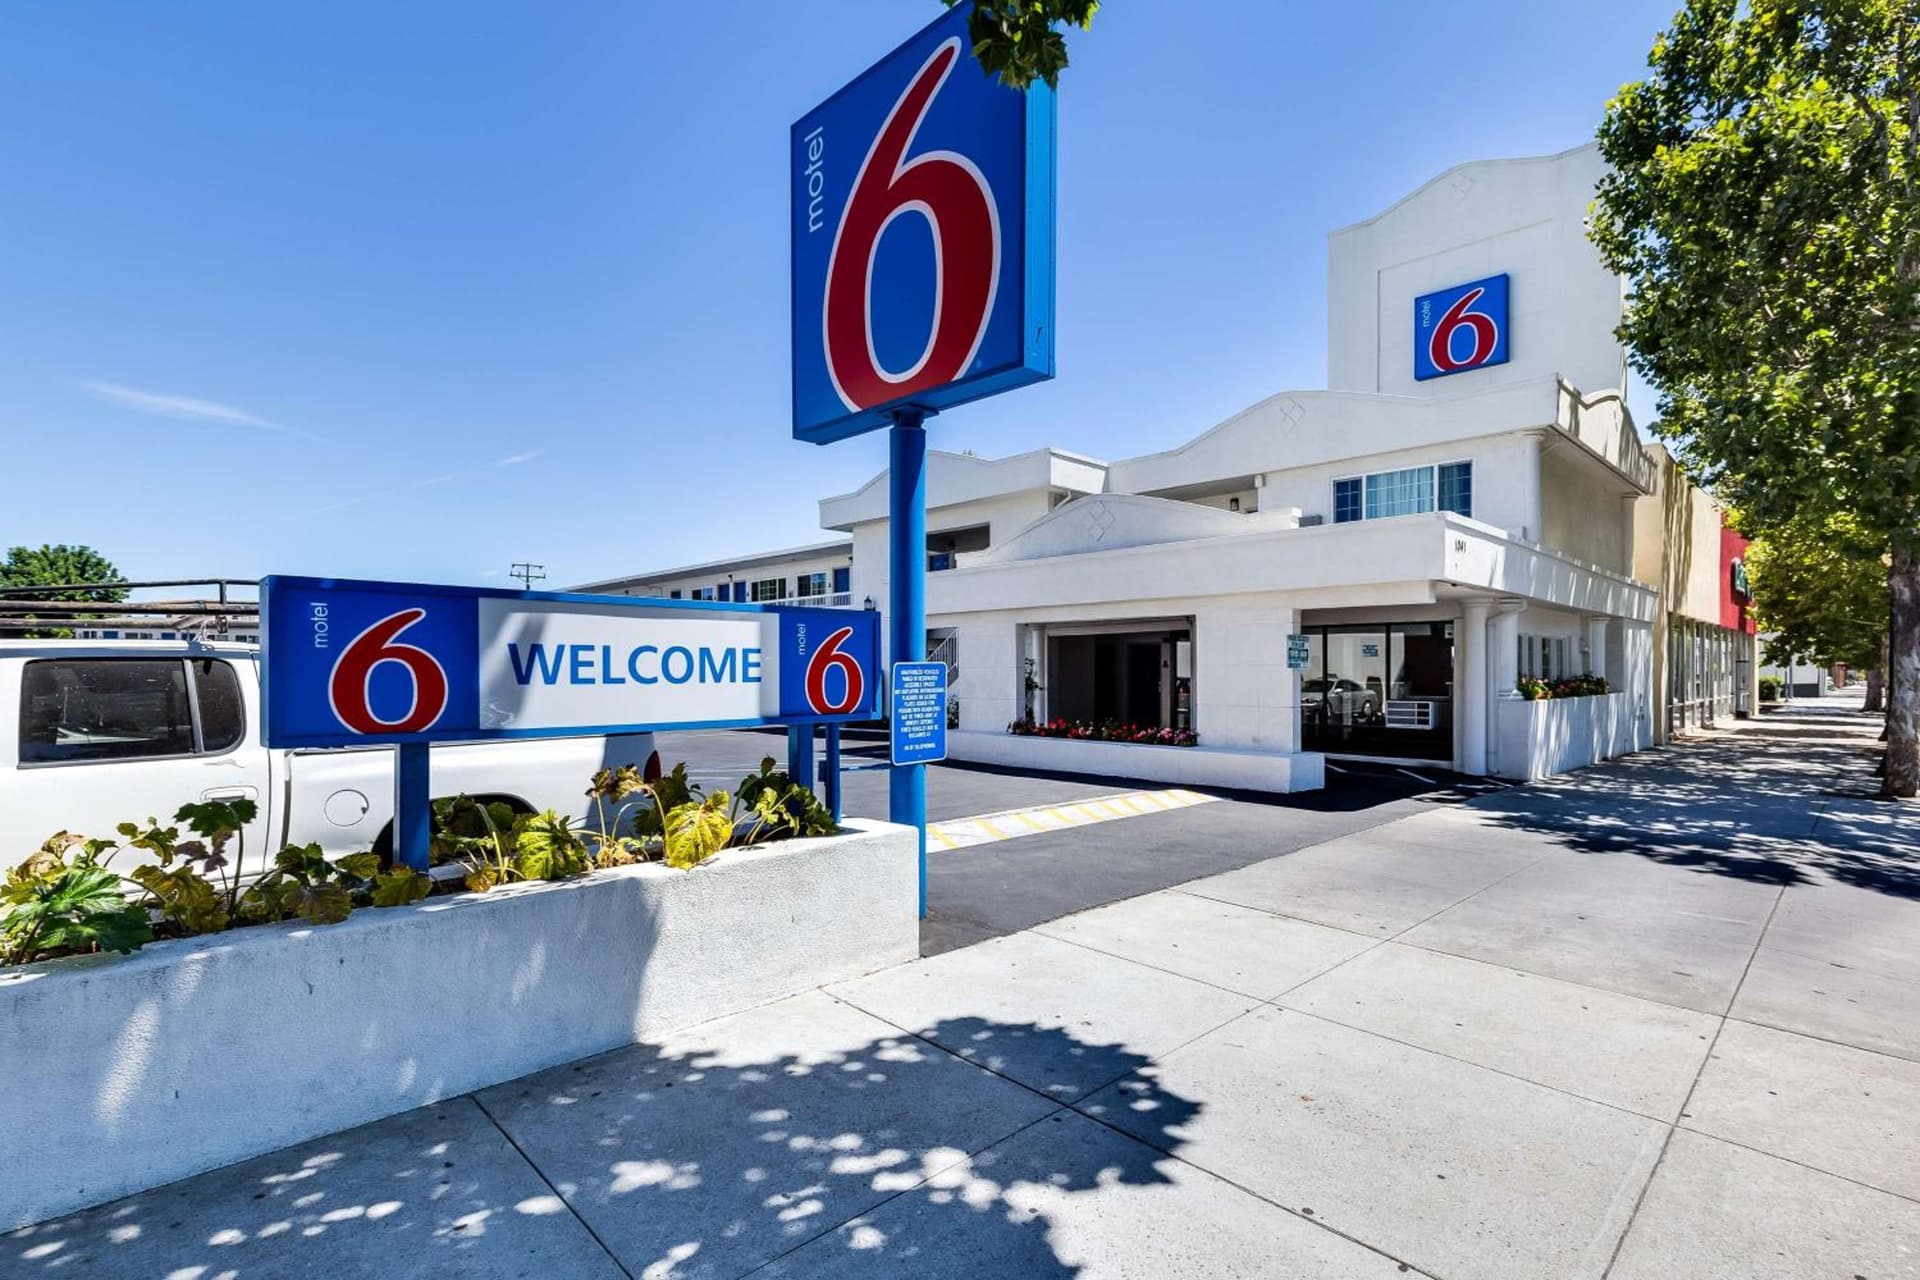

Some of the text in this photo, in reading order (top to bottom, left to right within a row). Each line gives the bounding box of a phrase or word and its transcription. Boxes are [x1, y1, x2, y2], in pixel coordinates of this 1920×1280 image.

[804, 35, 1001, 412] motel 6
[1421, 287, 1498, 372] motel 6
[310, 602, 448, 735] motel 6
[507, 643, 762, 685] WELCOME
[796, 623, 864, 714] motel 6
